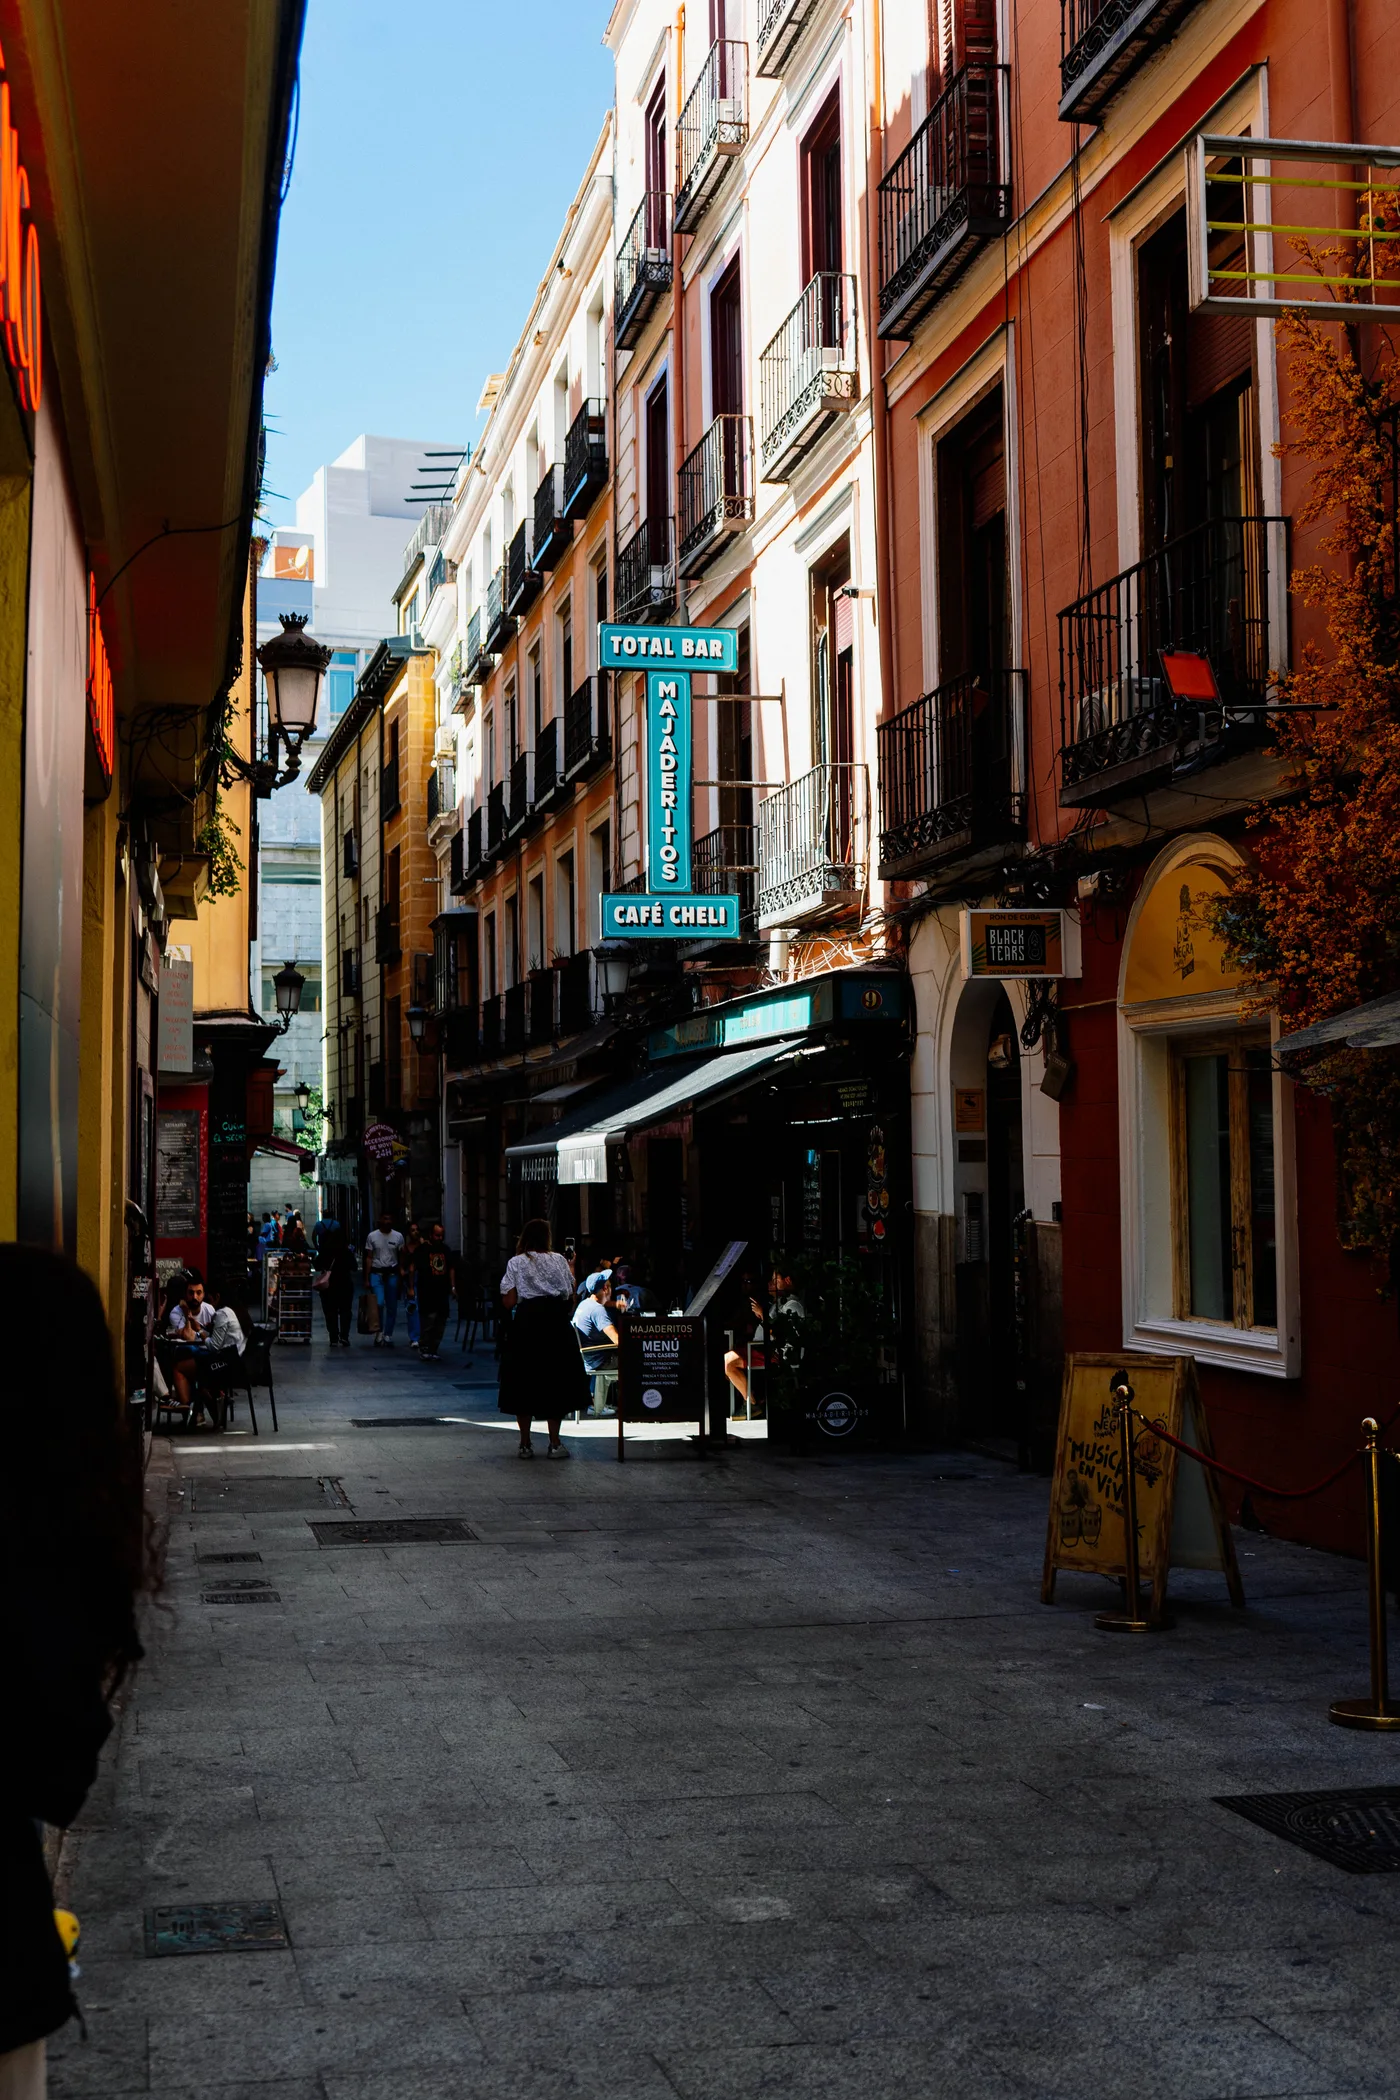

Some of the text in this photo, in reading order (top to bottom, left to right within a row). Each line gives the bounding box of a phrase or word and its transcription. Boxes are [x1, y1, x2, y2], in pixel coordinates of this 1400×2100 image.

[610, 636, 724, 658] TOTAL BAR
[658, 681, 678, 882] MAJADERITOS
[614, 902, 727, 926] CAFÉ CHELI
[989, 929, 1025, 945] BLACK
[990, 945, 1025, 961] TEARS
[1174, 943, 1194, 958] NEGRA
[865, 992, 877, 1008] 9
[364, 1134, 398, 1146] ACCESORIOS
[375, 1149, 392, 1159] 24H
[630, 1325, 693, 1334] MAJADERITOS
[643, 1337, 679, 1351] MENÚ
[1079, 1462, 1096, 1479] EN
